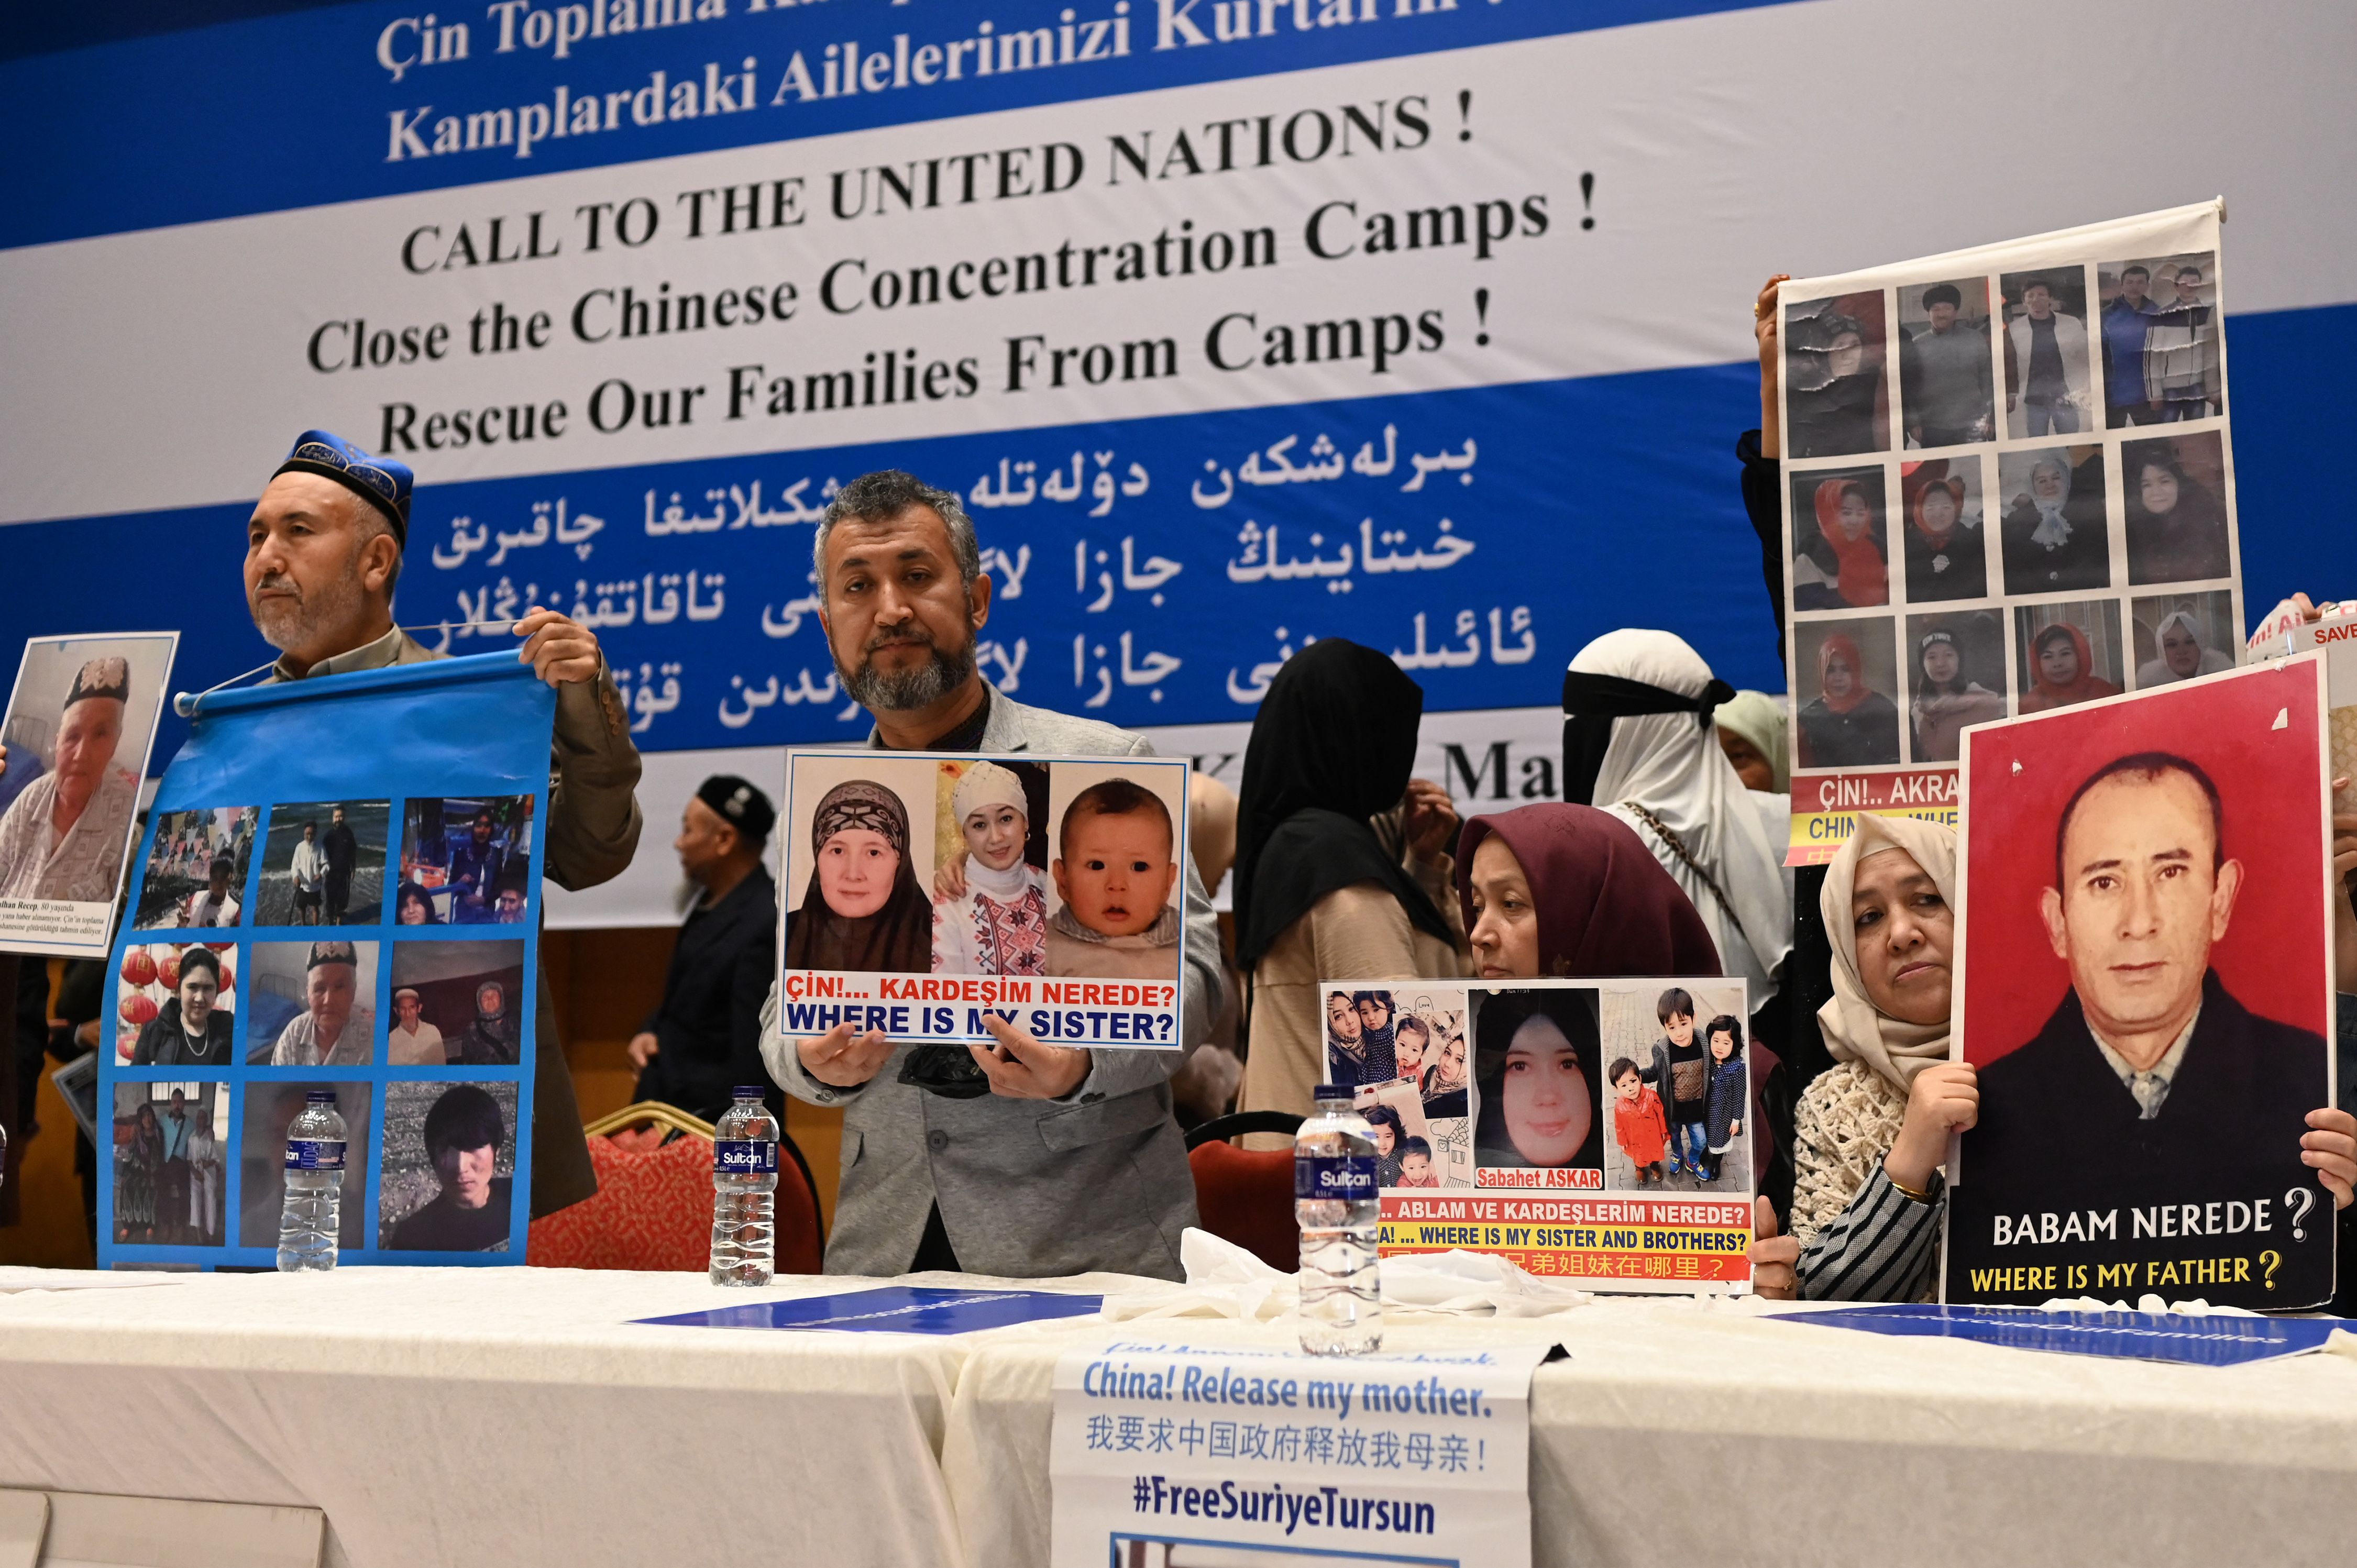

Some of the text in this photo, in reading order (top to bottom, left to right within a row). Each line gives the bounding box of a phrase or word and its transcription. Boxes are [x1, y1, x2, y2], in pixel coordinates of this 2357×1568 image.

[376, 0, 728, 81] Çin Toplama
[385, 57, 757, 161] Kamplardaki
[771, 2, 1131, 105] Ailelerimizi
[401, 89, 1472, 275] CALL TO THE UNITED NATIONS !
[307, 172, 1595, 374] Close the Chinese Concentration Camps !
[379, 288, 1490, 455] Rescue Our Families From Camps !
[1889, 774, 1959, 804] AKRA
[1809, 816, 1856, 839] CHIN
[786, 971, 1175, 1008] ÇİN!... KARDEŞİM NEREDE?
[787, 1003, 910, 1033] WHERE
[923, 1007, 955, 1034] IS
[1031, 1010, 1174, 1041] SISTER?
[723, 1152, 762, 1164] Sultan
[1320, 1171, 1371, 1187] Sultan
[1478, 1168, 1601, 1188] Sabahet ASKAR
[1397, 1200, 1745, 1225] ABLAM VE KARDEŞLERİM NEREDE?
[1993, 1187, 2316, 1245] BABAM NEREDE ?
[1419, 1227, 1479, 1244] WHERE
[1485, 1228, 1501, 1245] IS
[1506, 1228, 1531, 1245] MY
[1536, 1229, 1597, 1247] SISTER
[1602, 1230, 1637, 1249] AND
[1644, 1231, 1746, 1251] BROTHERS?
[1970, 1250, 2282, 1292] WHERE IS MY FATHER ?
[1084, 1362, 1492, 1420] China! Release my mother.
[1086, 1414, 1485, 1473] 我要求中国政府释放我母亲!
[1133, 1475, 1435, 1536] #FreeSuriyeTursun
